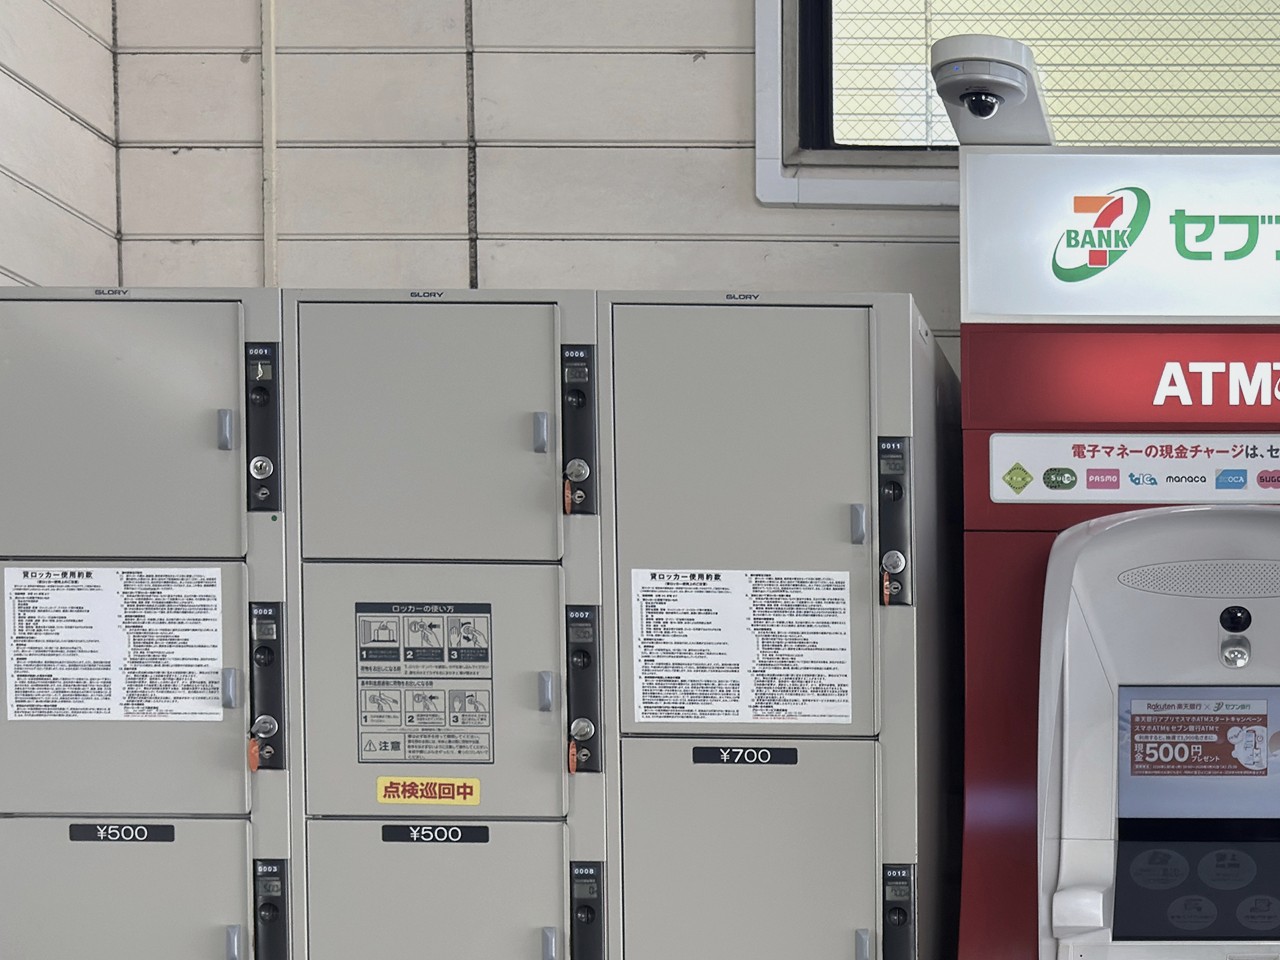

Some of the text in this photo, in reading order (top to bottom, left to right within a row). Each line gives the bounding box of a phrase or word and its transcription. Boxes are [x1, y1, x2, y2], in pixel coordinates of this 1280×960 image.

[1066, 229, 1130, 249] BANK
[1088, 474, 1118, 482] PASMO
[1166, 475, 1207, 484] manaca
[23, 570, 94, 579] 貸ロッカー使用約款
[650, 572, 722, 581] 貸ロッカー使用約款
[392, 605, 455, 613] ロッカーの使い方
[361, 650, 367, 659] 1
[406, 650, 414, 660] 2
[450, 650, 458, 660] 3
[1146, 702, 1176, 712] Rakuten
[363, 715, 368, 723] 1
[407, 715, 414, 723] 2
[378, 741, 401, 752] 注意
[720, 748, 771, 763] ¥700
[1145, 743, 1202, 763] 500 円
[1191, 755, 1220, 763] プレゼント
[383, 781, 474, 800] 点検巡回中
[96, 825, 148, 840] ¥500
[409, 826, 462, 842] ¥500
